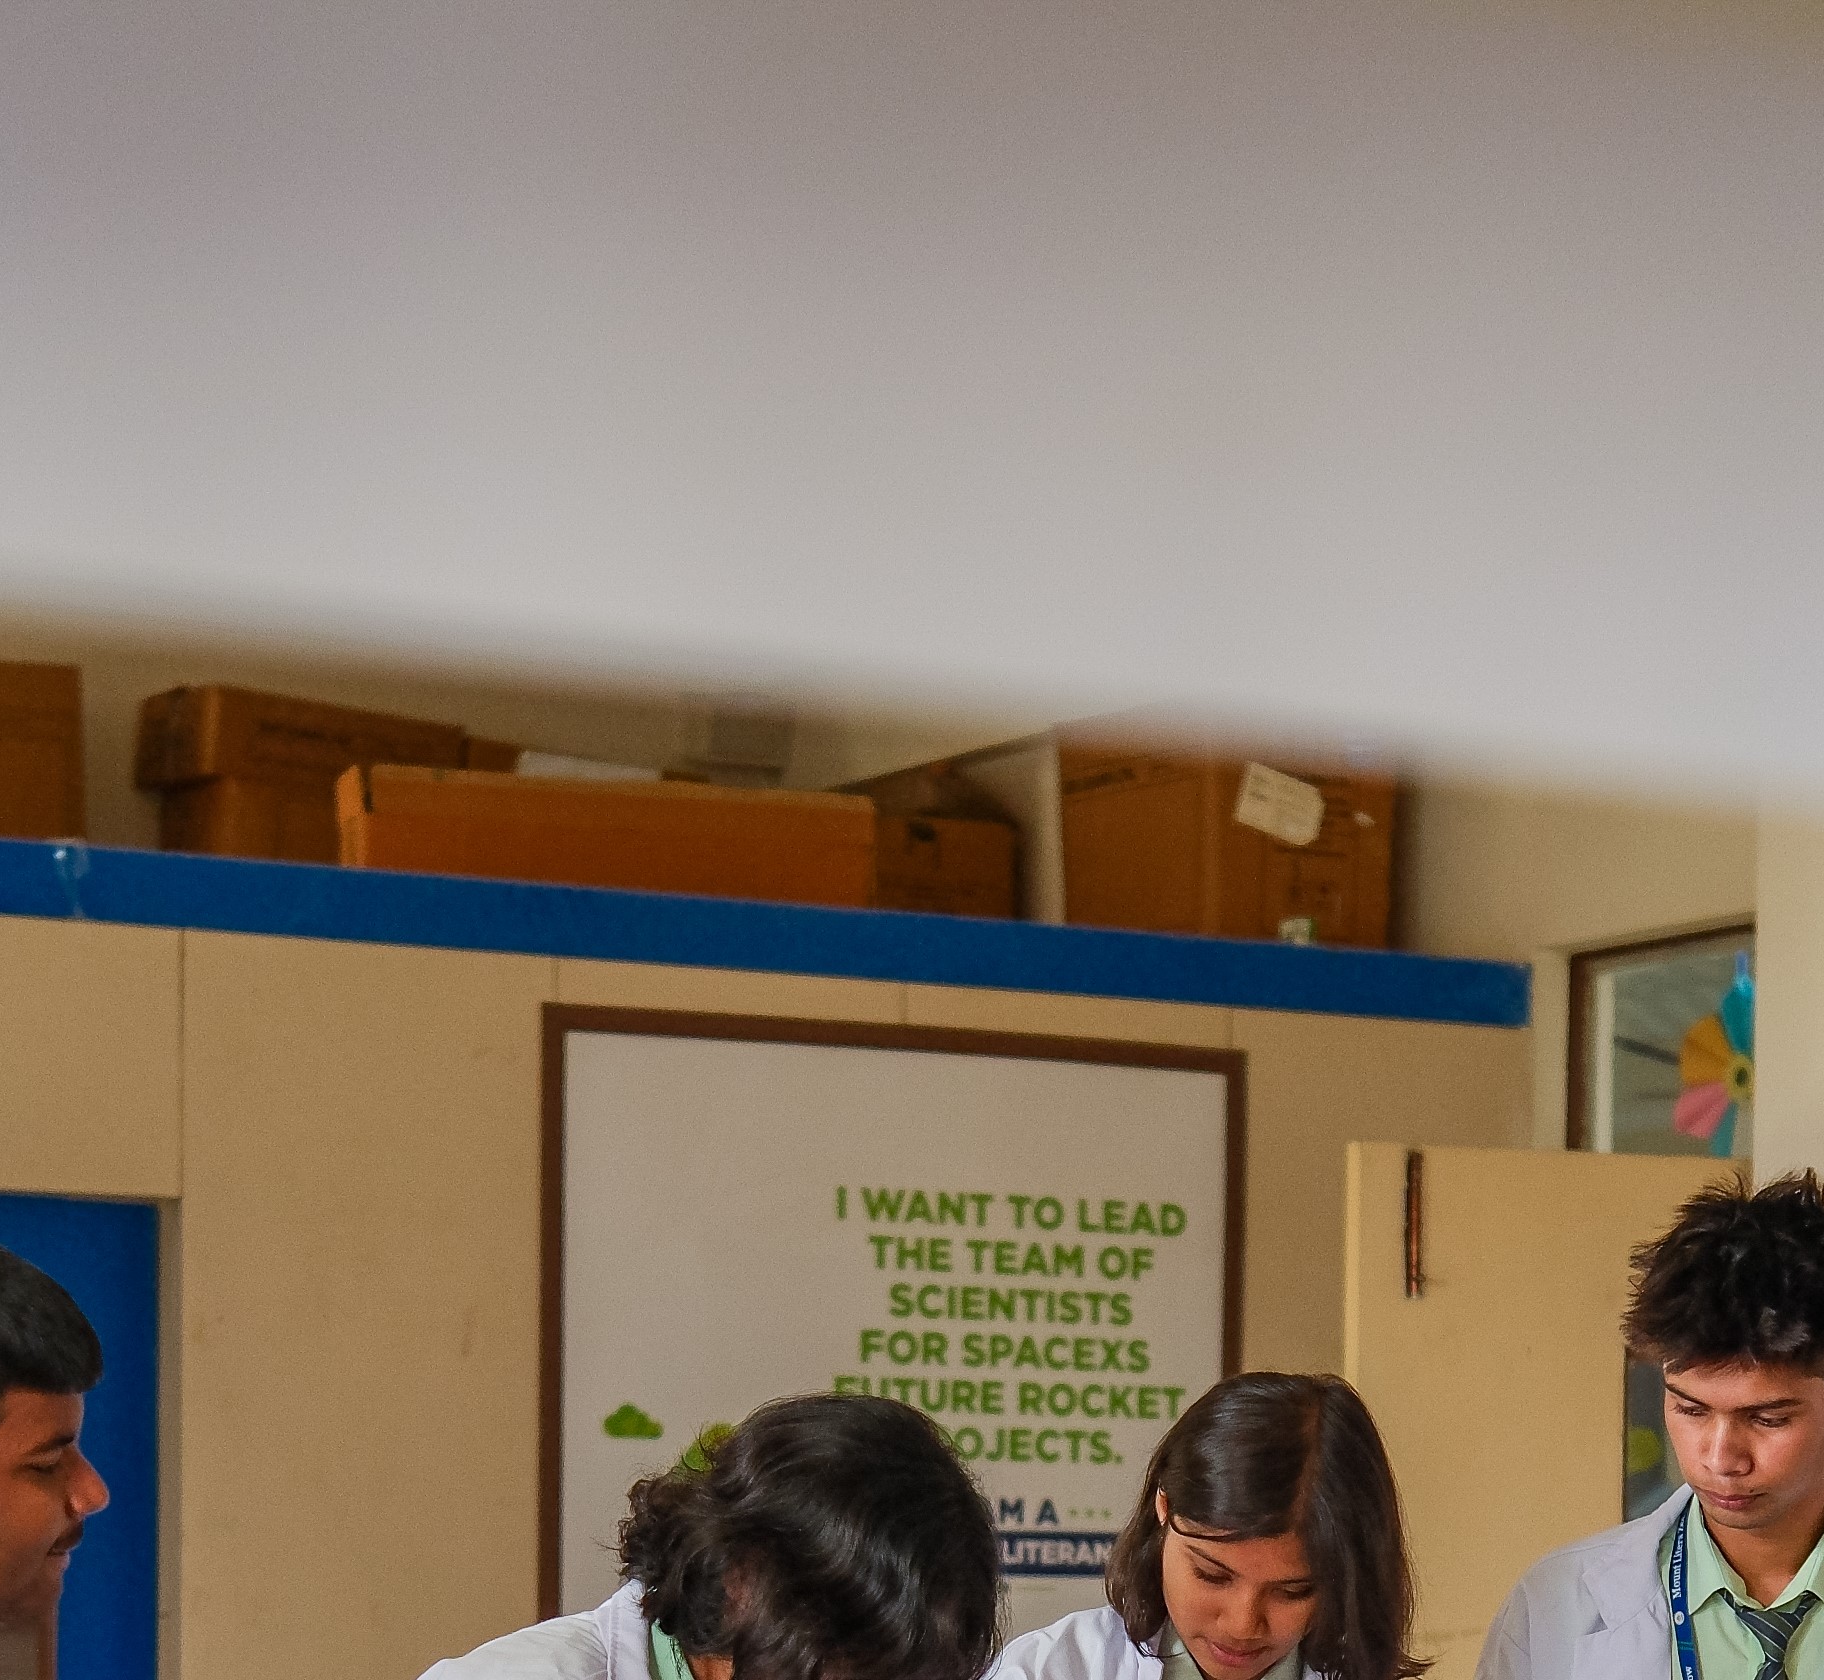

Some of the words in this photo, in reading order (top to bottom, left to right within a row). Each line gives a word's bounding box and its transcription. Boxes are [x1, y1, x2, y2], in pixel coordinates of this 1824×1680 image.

[835, 1185, 847, 1220] I
[860, 1187, 993, 1228] WANT
[1008, 1194, 1065, 1231] TO
[1076, 1199, 1188, 1237] LEAD
[868, 1234, 953, 1273] THE
[966, 1239, 1085, 1279] TEAM
[1097, 1246, 1155, 1281] OF
[888, 1282, 1134, 1327] SCIENTISTS
[859, 1328, 949, 1366] FOR
[961, 1333, 1151, 1374] SPACEXS
[1017, 1380, 1186, 1420] ROCKET
[942, 1426, 1123, 1465] OJECTS.
[1036, 1498, 1059, 1526] A
[1673, 1532, 1684, 1562] Litera
[1671, 1563, 1682, 1600] Mount
